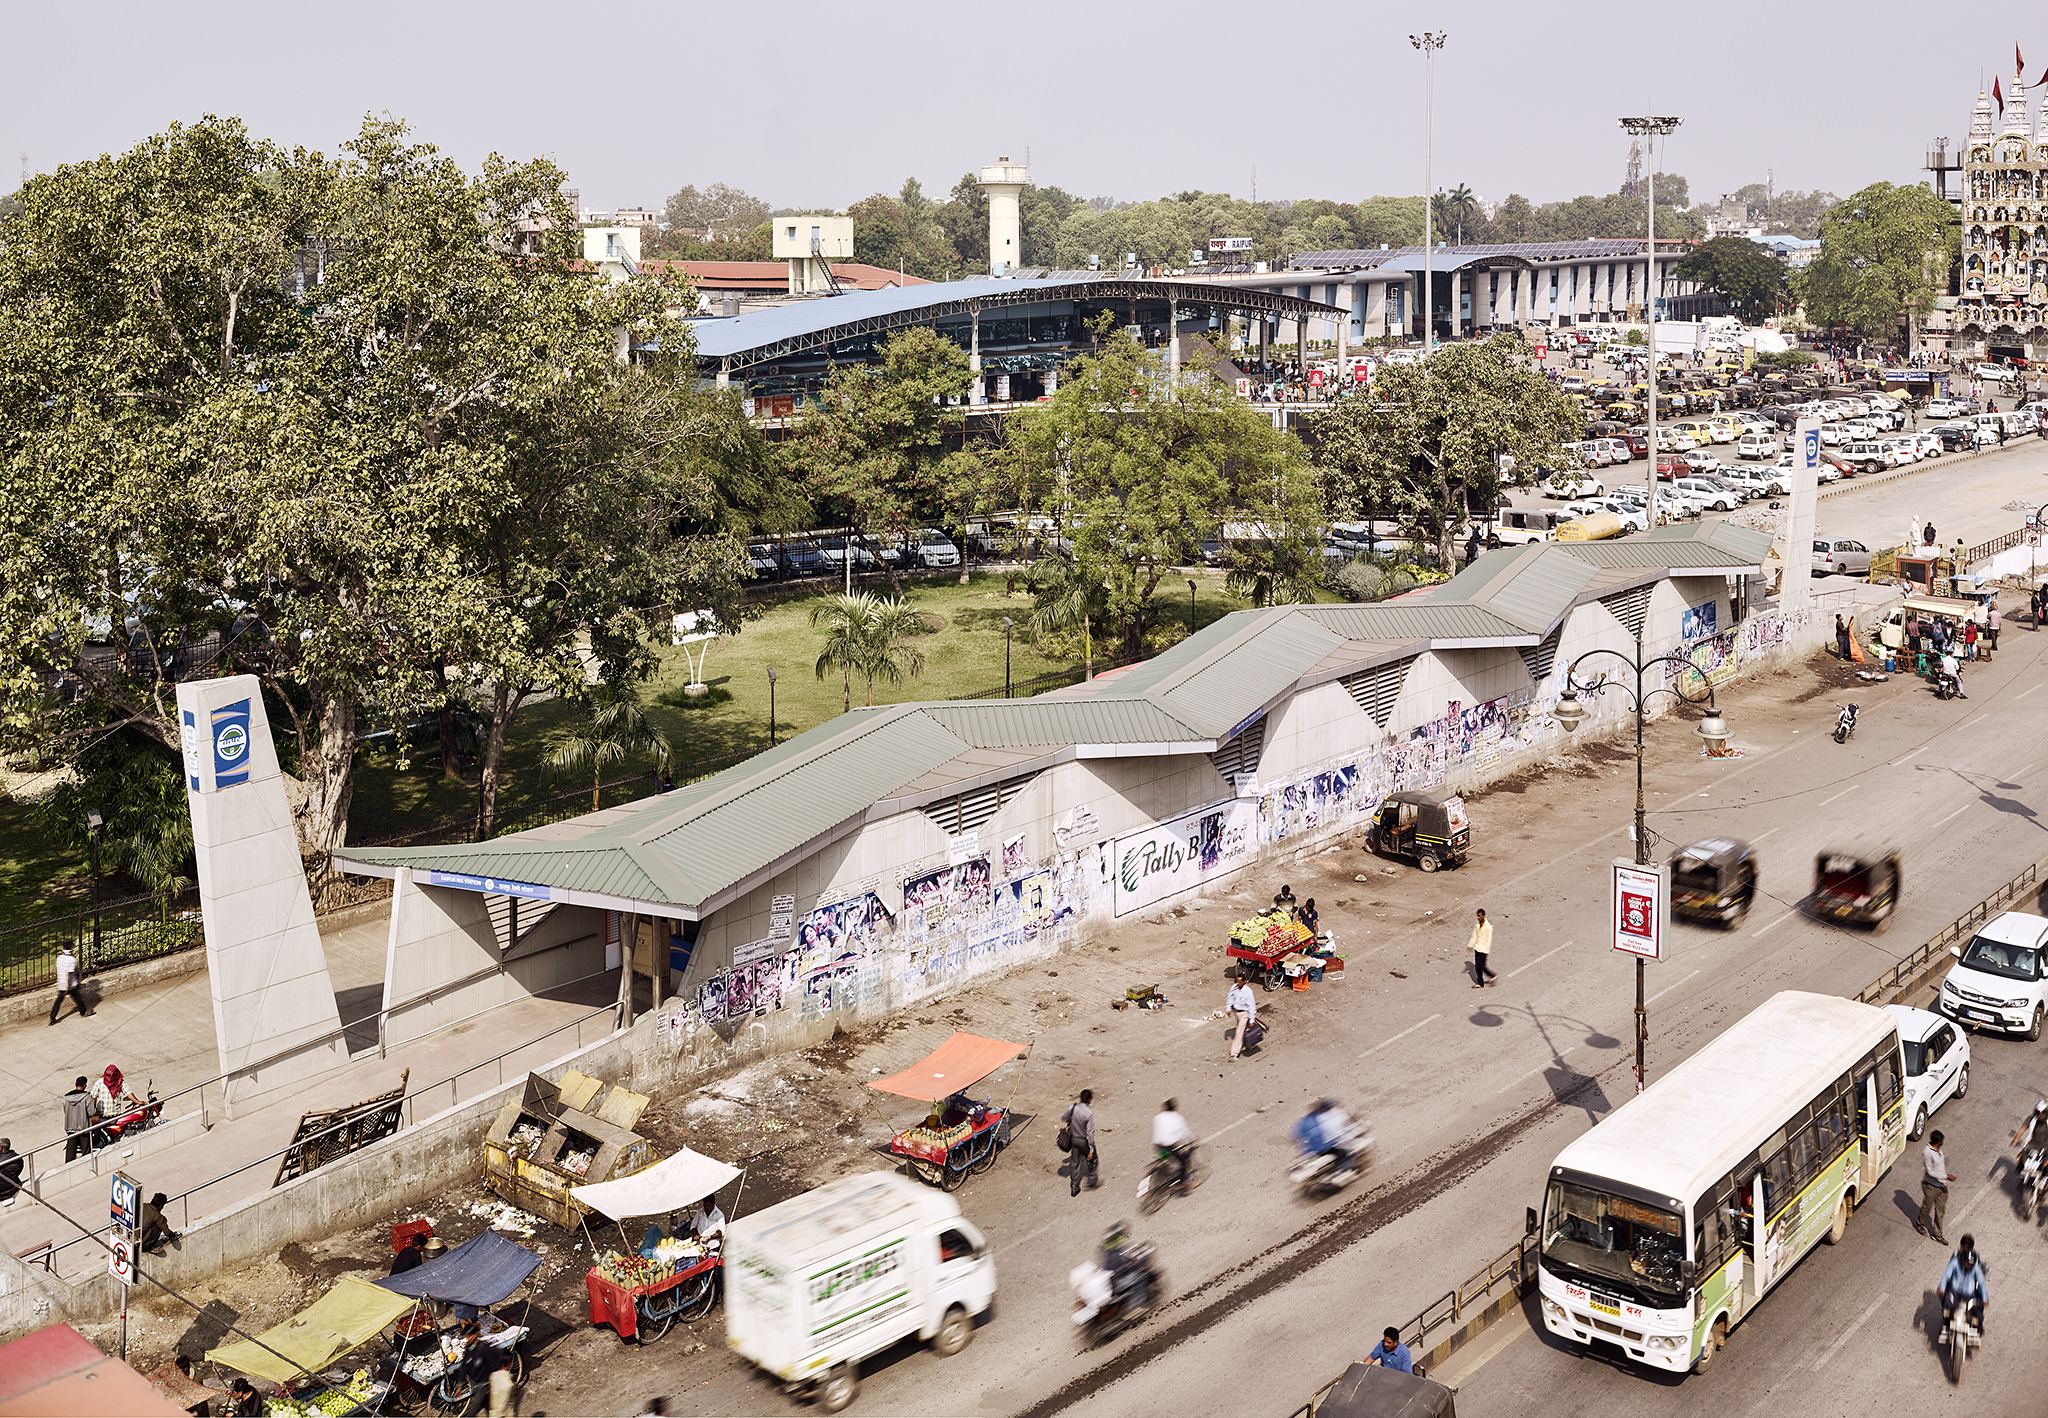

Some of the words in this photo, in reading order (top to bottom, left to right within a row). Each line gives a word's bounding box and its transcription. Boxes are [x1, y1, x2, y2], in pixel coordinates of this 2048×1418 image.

[1231, 239, 1253, 248] RAIPUR
[1142, 840, 1185, 878] Tally
[112, 1178, 134, 1213] GK
[1566, 1284, 1586, 1300] सिटी
[1625, 1305, 1642, 1318] बस
